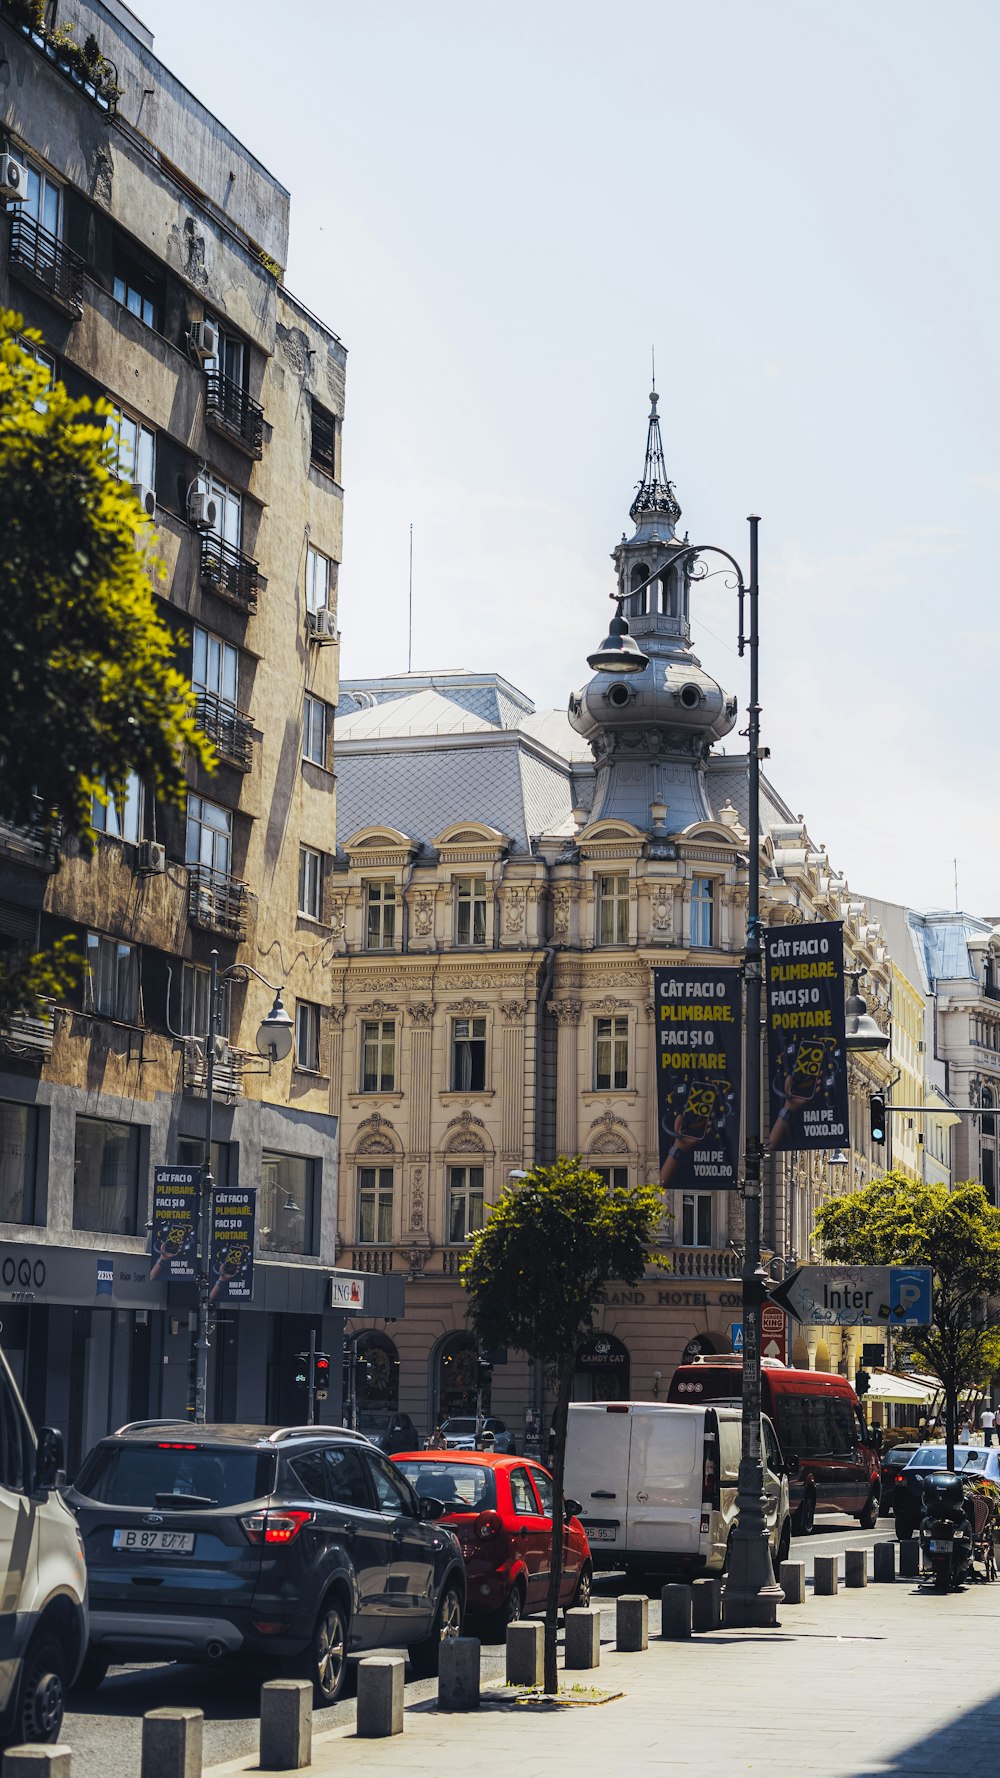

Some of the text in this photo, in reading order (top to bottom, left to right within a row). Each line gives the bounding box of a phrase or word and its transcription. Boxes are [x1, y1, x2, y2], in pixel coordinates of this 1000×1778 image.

[770, 938, 829, 958] CÂT FACI O
[771, 961, 838, 982] PLIMBARE,
[660, 979, 726, 997] CÂT FACI O
[771, 988, 820, 1007] FACI ȘI O
[660, 1005, 735, 1022] PLIMBARE,
[772, 1010, 832, 1030] PORTARE
[661, 1031, 714, 1048] FACI ȘI O
[662, 1053, 726, 1069] PORTARE
[804, 1110, 833, 1122] HAI PE
[804, 1124, 844, 1136] YOXO.RO
[694, 1151, 724, 1162] HAI PE
[157, 1172, 192, 1182] CÂT FACI O
[694, 1165, 732, 1176] YOXO.RO
[156, 1186, 196, 1195] PLIMBARE,
[216, 1193, 226, 1202] CÂT
[156, 1210, 190, 1219] PORTARE
[215, 1232, 248, 1240] PORTARE
[97, 1270, 114, 1280] ZEISS
[333, 1284, 350, 1302] ING
[658, 1292, 710, 1305] HOTEL
[824, 1284, 874, 1309] Inter
[581, 1354, 624, 1362] CANDY CAT
[126, 1532, 136, 1546] B
[141, 1532, 157, 1546] 87
